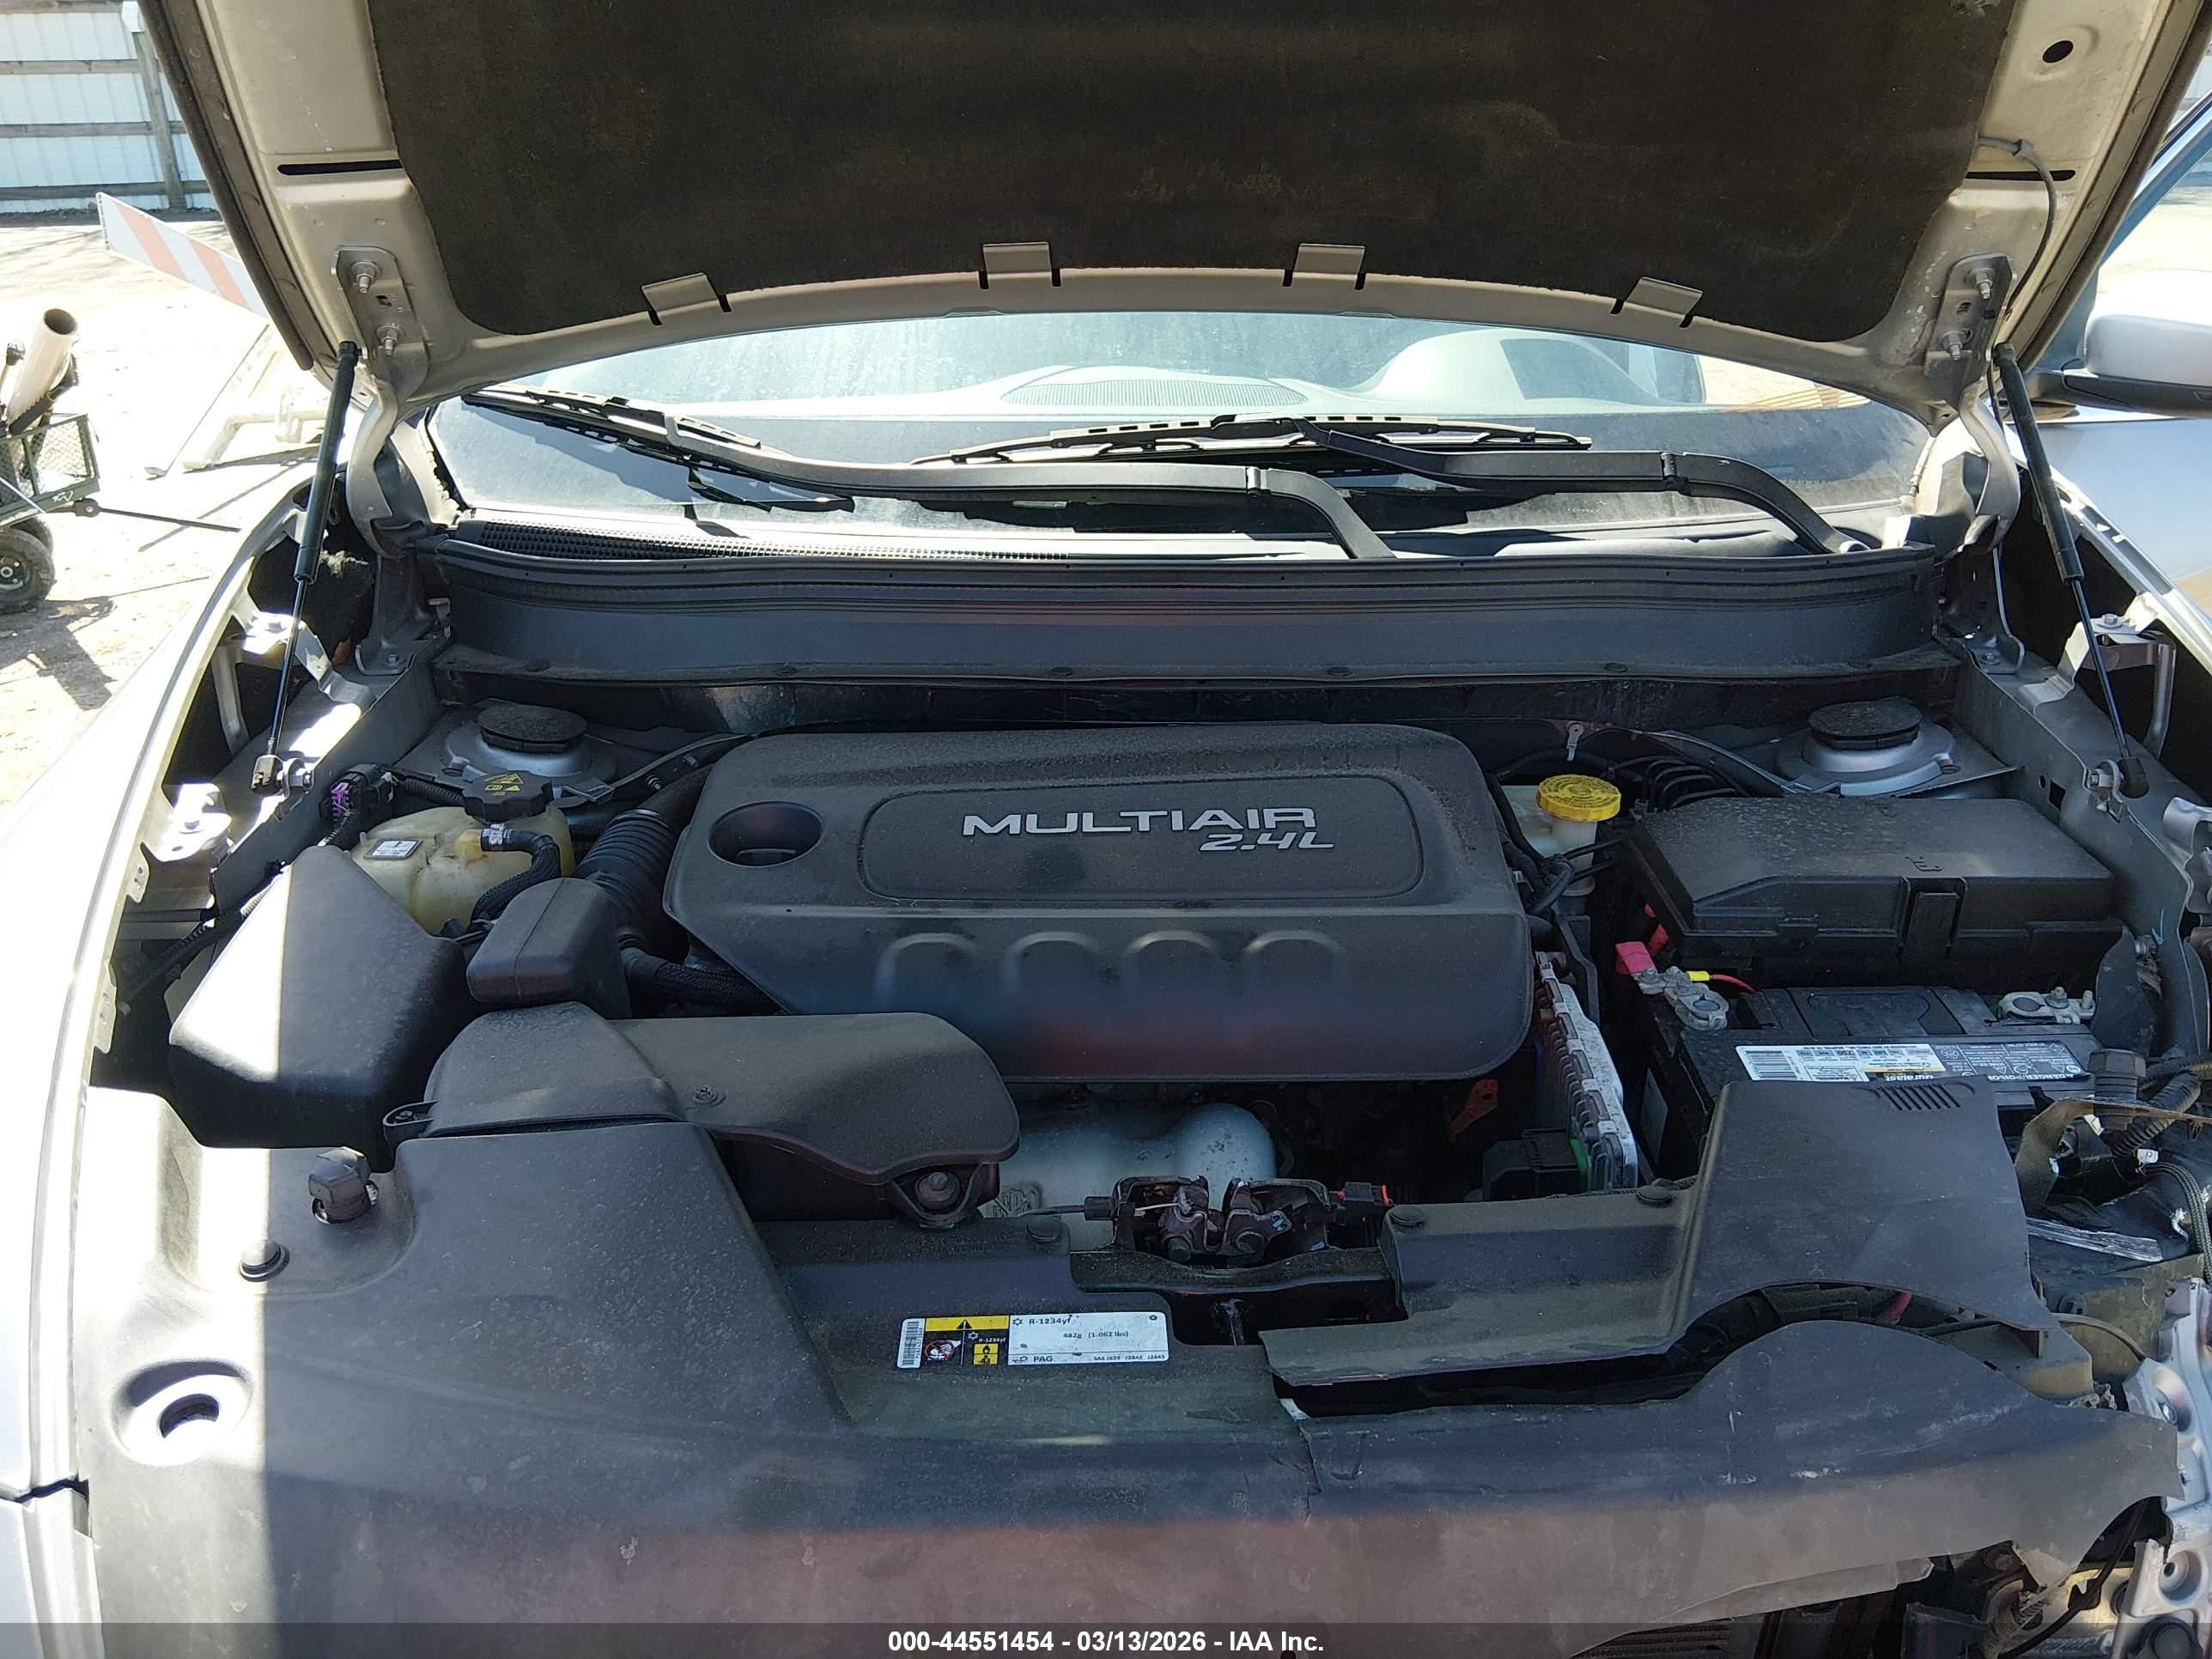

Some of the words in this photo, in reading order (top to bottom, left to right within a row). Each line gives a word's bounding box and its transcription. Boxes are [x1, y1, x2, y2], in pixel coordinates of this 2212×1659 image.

[962, 807, 1317, 836] MULTIAIR
[1199, 831, 1335, 852] 2.4L
[1029, 1316, 1072, 1326] R-1234yf
